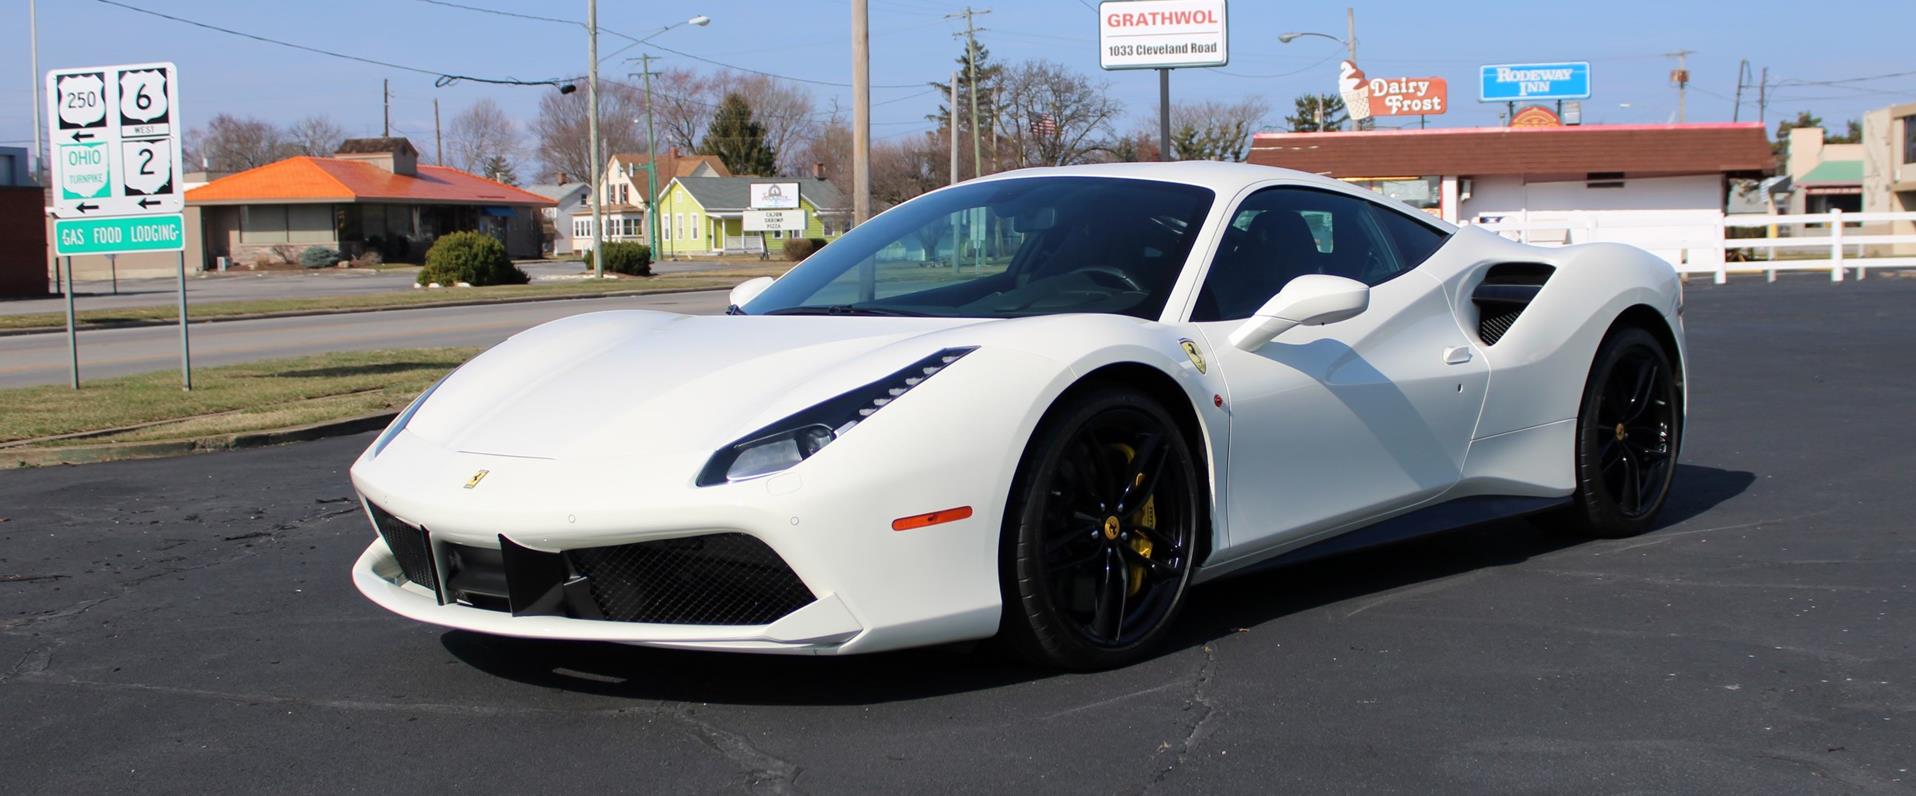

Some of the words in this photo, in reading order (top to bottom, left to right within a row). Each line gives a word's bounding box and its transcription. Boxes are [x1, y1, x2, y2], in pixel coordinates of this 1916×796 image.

[1107, 10, 1218, 28] GRATHWOL
[1109, 45, 1134, 56] 1033
[1136, 43, 1188, 56] Cleveland
[1191, 42, 1217, 54] Road
[1497, 68, 1572, 82] RODEWAY
[136, 84, 151, 109] 6
[1370, 78, 1429, 97] Dairy
[1519, 81, 1551, 96] INN
[68, 91, 96, 109] 250
[1384, 95, 1441, 115] Frost
[134, 126, 155, 134] WEST
[68, 149, 101, 166] OHIO
[139, 149, 154, 175] 2
[69, 173, 103, 184] TURNPIKE
[63, 229, 85, 245] GAS
[93, 227, 122, 244] FOOD
[130, 225, 176, 242] LODGING
